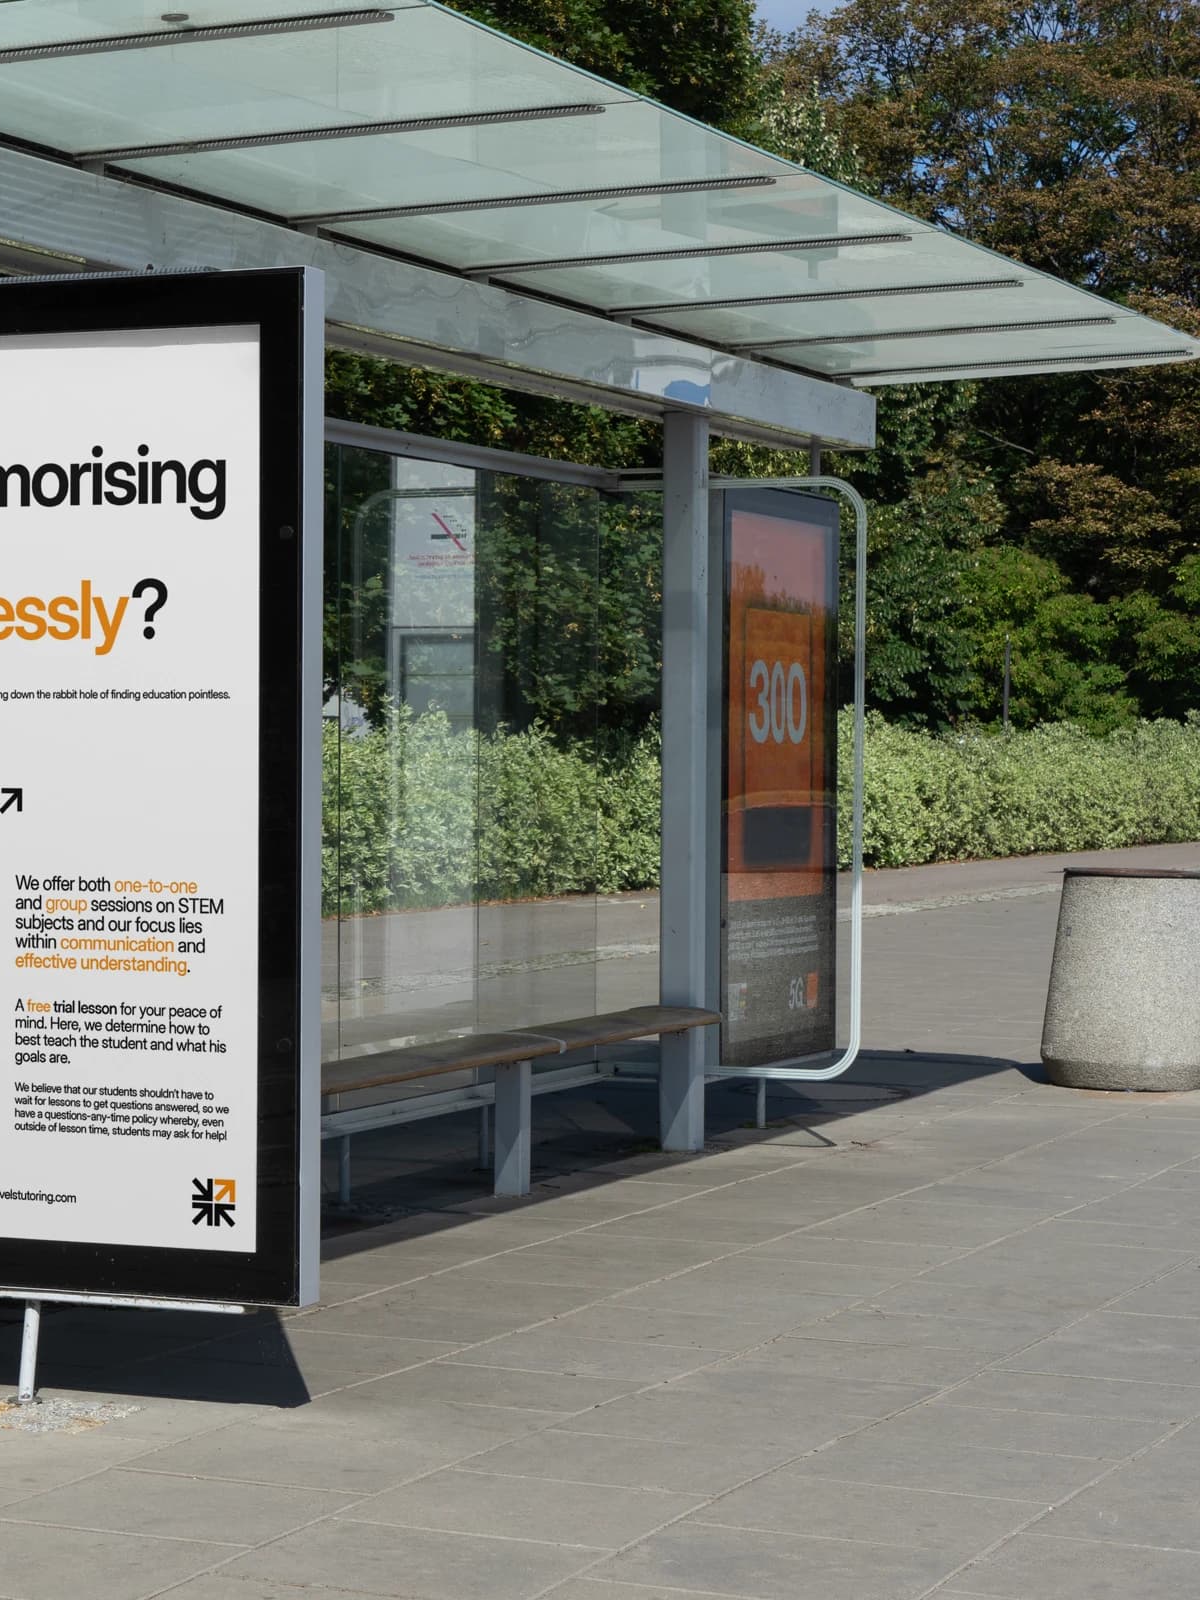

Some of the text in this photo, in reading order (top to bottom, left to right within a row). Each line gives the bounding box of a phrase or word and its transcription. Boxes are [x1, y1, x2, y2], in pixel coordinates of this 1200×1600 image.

[10, 689, 35, 699] down
[36, 689, 51, 699] the
[53, 689, 78, 699] rabbit
[79, 689, 98, 699] hole
[100, 689, 109, 699] of
[111, 689, 141, 702] finding
[142, 689, 187, 699] education
[188, 689, 231, 701] pointless.
[749, 659, 807, 744] 300
[15, 875, 198, 894] We offer both one-to-one
[15, 895, 224, 915] and group sessions on STEM
[15, 914, 203, 934] subjects and our focus lies
[15, 933, 205, 954] within communication and
[15, 953, 191, 977] effective understanding.
[15, 998, 222, 1021] A free trial lesson for your peace of
[15, 1016, 210, 1036] mind. Here, we determine how to
[15, 1032, 227, 1054] best teach the student and what his
[15, 1050, 71, 1066] goals are.
[14, 1082, 30, 1092] We
[31, 1083, 62, 1094] believe
[63, 1084, 81, 1095] that
[82, 1087, 98, 1095] our
[99, 1086, 138, 1097] students
[181, 1089, 203, 1100] have
[204, 1091, 214, 1101] to
[14, 1095, 230, 1115] wait for lessons to get questions answered, so we
[15, 1108, 224, 1128] have a questions-any-time policy whereby, even
[14, 1121, 47, 1132] outside
[48, 1122, 57, 1132] of
[59, 1122, 87, 1134] lesson
[88, 1124, 110, 1136] time,
[112, 1126, 151, 1137] students
[152, 1130, 172, 1140] may
[173, 1129, 190, 1139] ask
[191, 1129, 204, 1140] for
